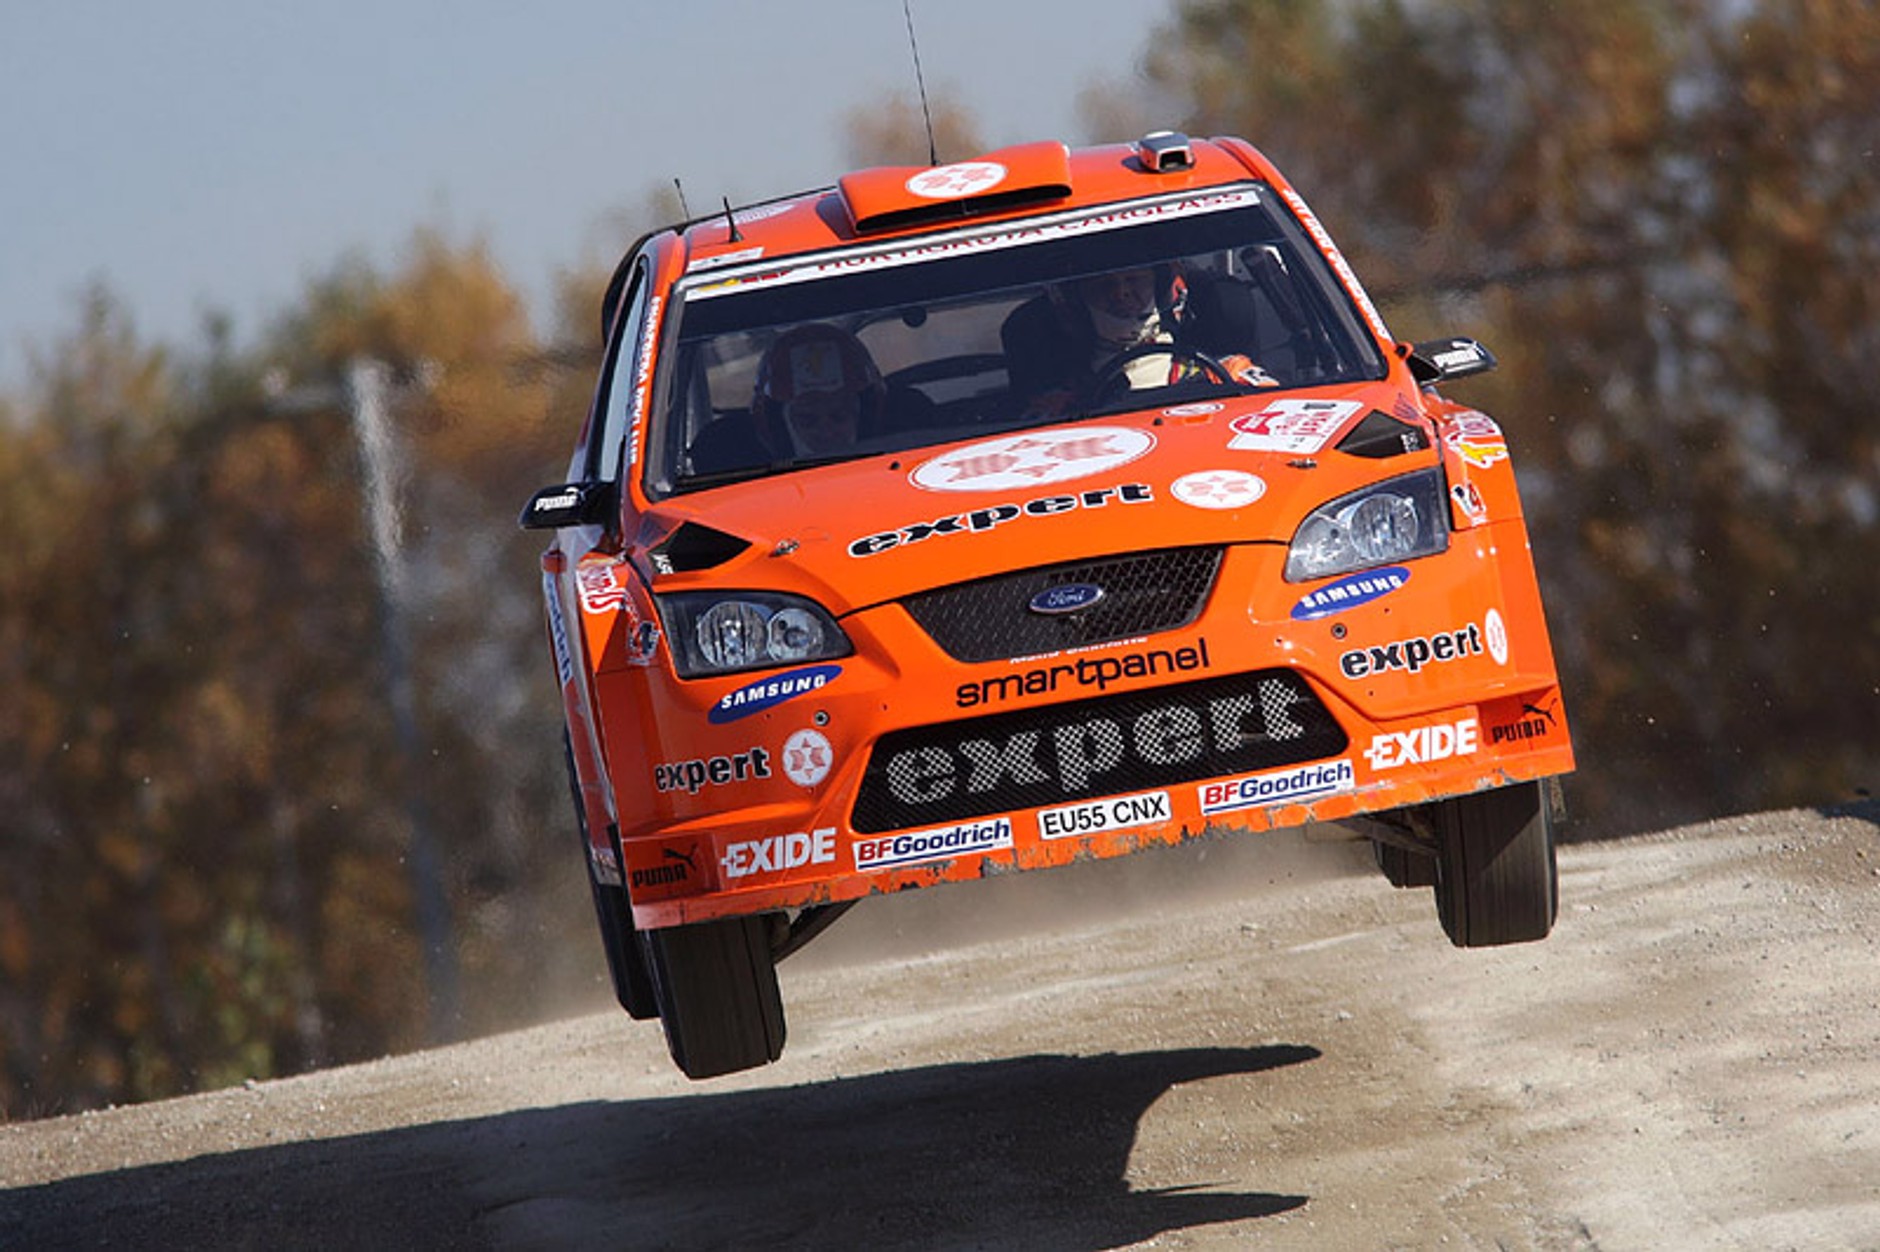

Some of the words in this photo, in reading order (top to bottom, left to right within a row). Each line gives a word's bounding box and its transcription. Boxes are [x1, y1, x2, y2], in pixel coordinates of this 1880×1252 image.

[848, 484, 1153, 557] expert
[1048, 588, 1086, 608] Ford
[1300, 575, 1403, 609] SAMSUNG
[955, 637, 1211, 709] smartpanel
[1340, 622, 1482, 680] expert
[720, 674, 827, 710] SAMSUNG
[886, 678, 1307, 805] expert
[1363, 718, 1478, 771] EXIDE
[1491, 718, 1548, 744] PUMA
[654, 746, 772, 796] expert
[1203, 762, 1352, 806] BFGoodrich
[1042, 803, 1107, 837] EU55
[1112, 795, 1168, 828] CNX
[720, 827, 838, 879] EXIDE
[857, 819, 1011, 863] BFGoodrich
[631, 863, 688, 889] PUMA
